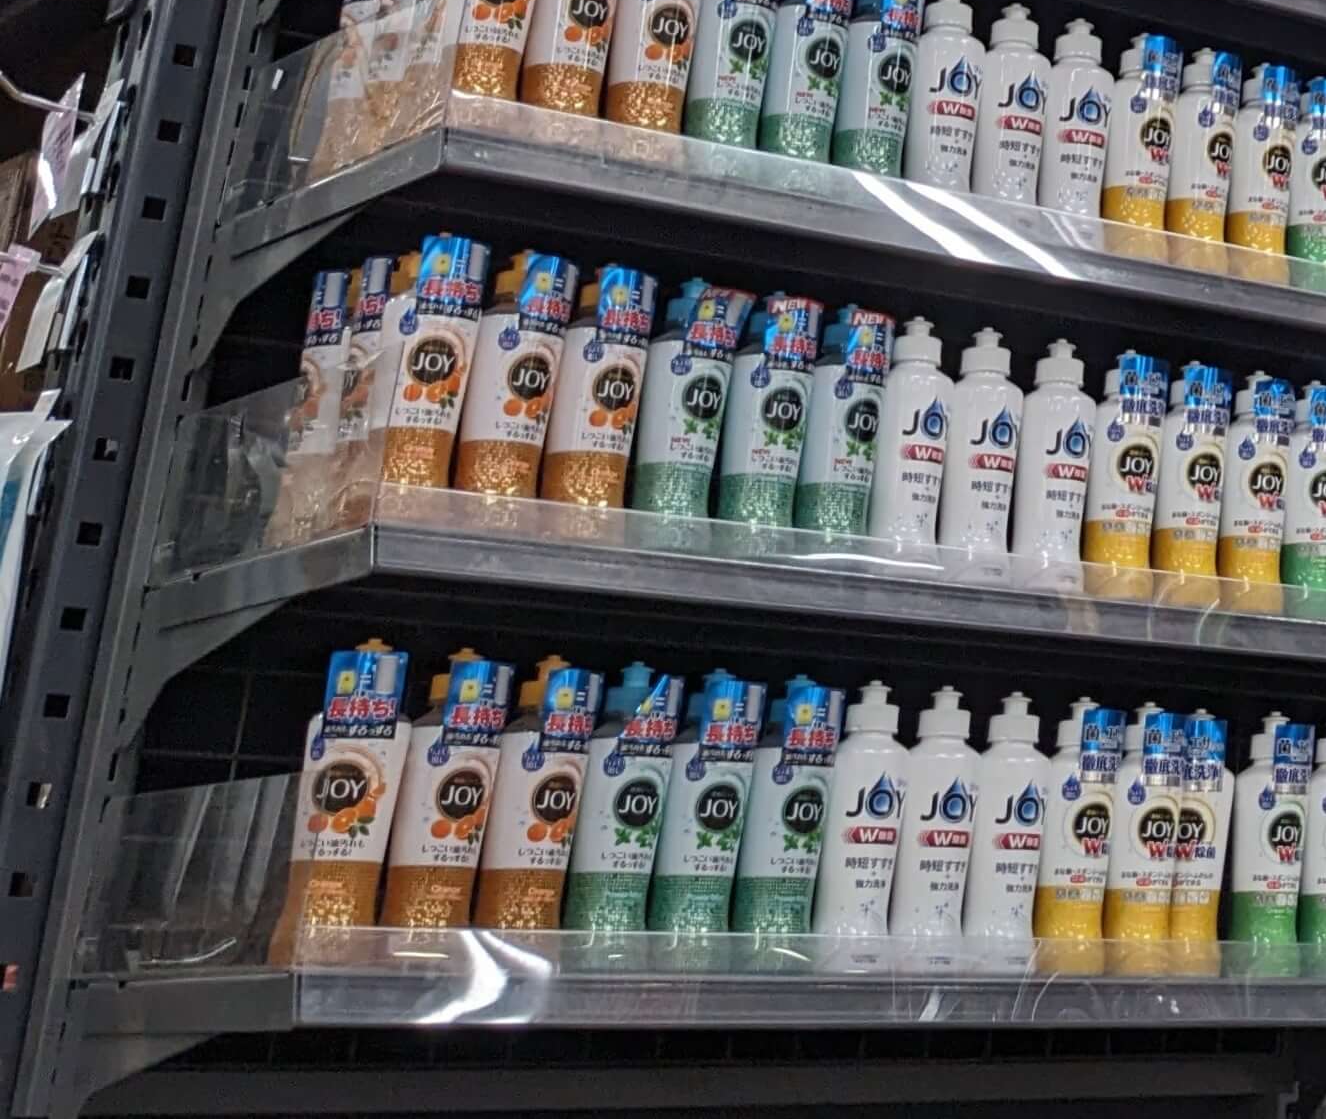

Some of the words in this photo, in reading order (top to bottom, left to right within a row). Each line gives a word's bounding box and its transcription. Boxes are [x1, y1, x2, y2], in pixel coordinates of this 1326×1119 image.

[571, 0, 607, 19] JOY
[652, 16, 689, 35] JOY
[731, 30, 766, 49] JOY
[810, 50, 841, 71] JOY
[930, 61, 982, 99] JOY
[1059, 90, 1111, 128] JOY
[772, 299, 809, 313] NEW
[854, 312, 884, 326] NEW
[412, 350, 455, 375] JOY
[511, 367, 550, 391] JOY
[596, 379, 634, 402] JOY
[687, 390, 722, 409] JOY
[766, 402, 801, 421] JOY
[848, 413, 879, 431] JOY
[1119, 455, 1154, 475] JOY
[1190, 464, 1221, 483] JOY
[1251, 473, 1282, 491] JOY
[316, 778, 367, 800] JOY
[441, 785, 482, 805] JOY
[846, 778, 905, 819] JOY
[537, 791, 575, 810] JOY
[618, 794, 658, 815] JOY
[700, 800, 738, 819] JOY
[920, 782, 978, 823] JOY
[787, 803, 823, 821] JOY
[1077, 817, 1109, 834] JOY
[1142, 820, 1175, 838] JOY
[1272, 825, 1300, 842] JOY
